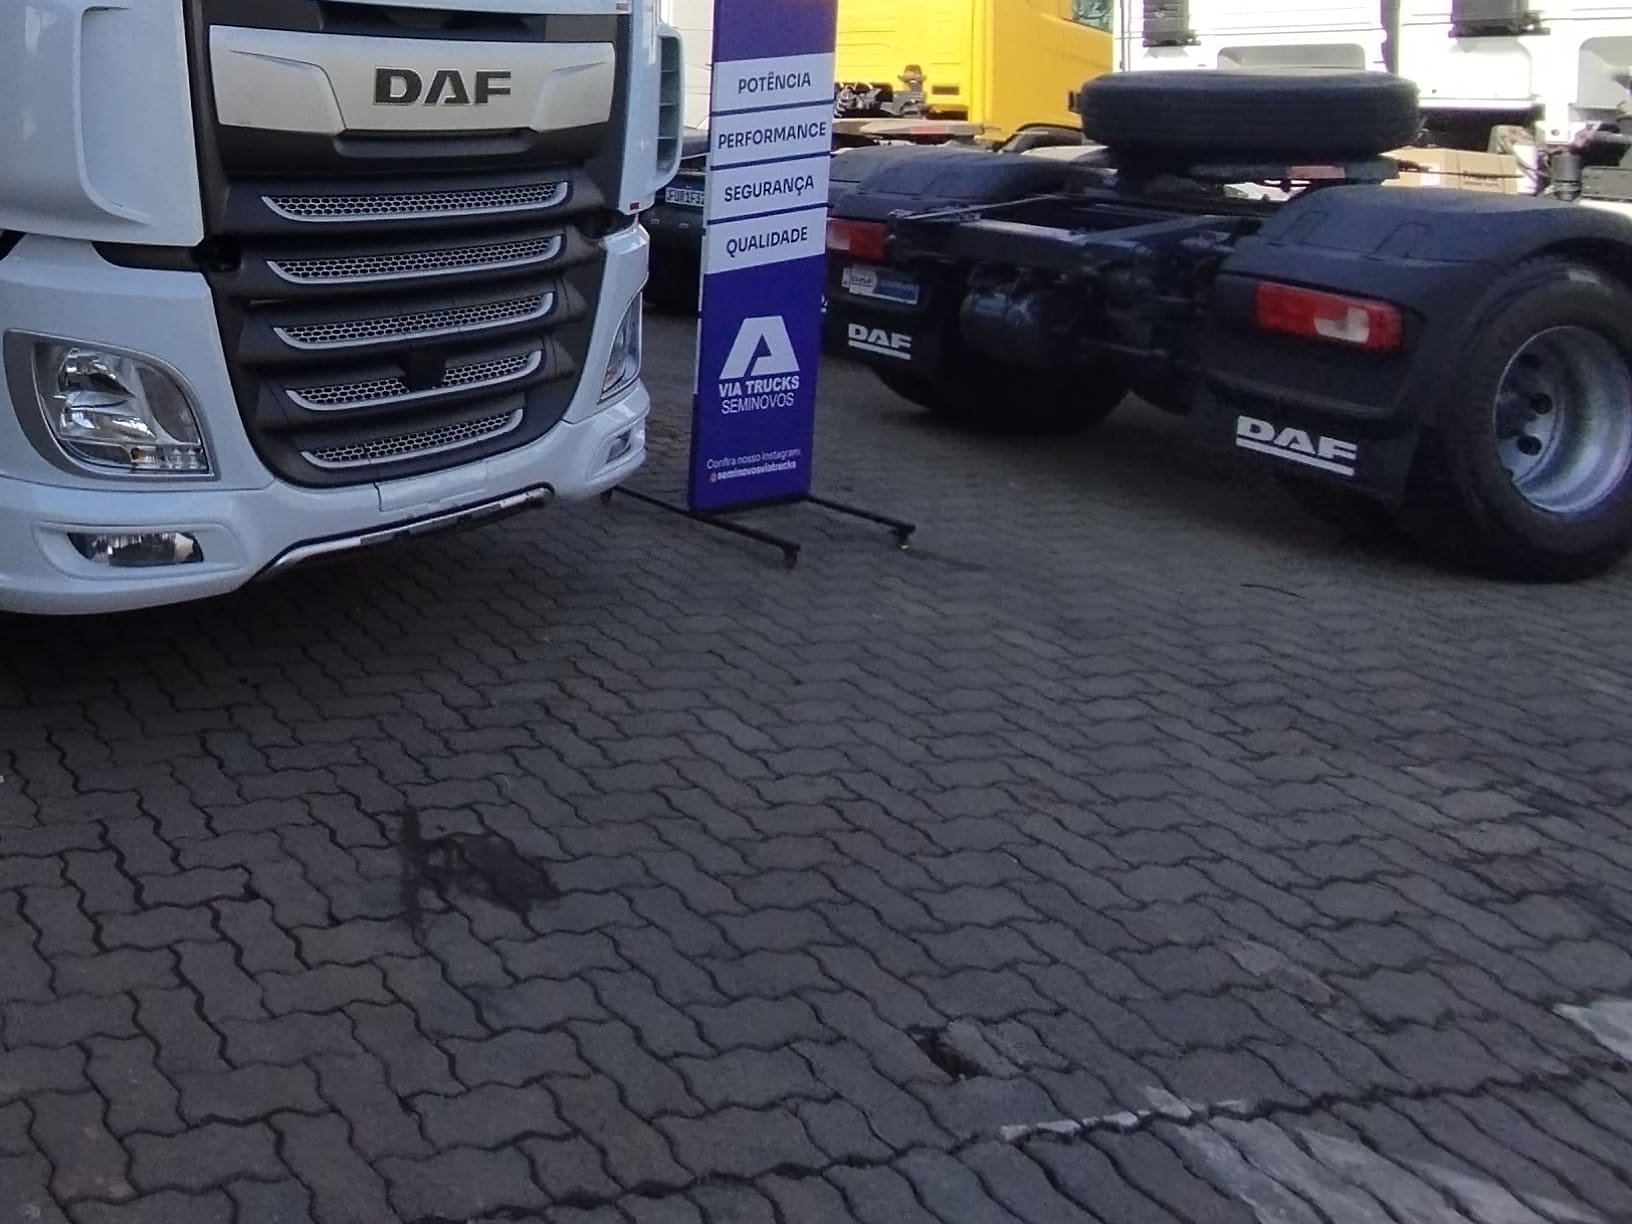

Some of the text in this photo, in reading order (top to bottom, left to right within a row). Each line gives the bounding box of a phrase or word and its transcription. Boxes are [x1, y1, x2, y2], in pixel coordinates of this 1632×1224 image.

[374, 67, 512, 105] DAF
[738, 71, 811, 94] POTÊNCIA
[718, 122, 827, 149] PERFORMANCE
[724, 175, 814, 202] SEGURANÇA
[726, 226, 808, 258] QUALIDADE
[848, 323, 912, 349] DAF
[718, 376, 800, 397] VIA TRUCKS
[721, 392, 795, 414] SEMINOVOS
[1236, 415, 1358, 460] DAF
